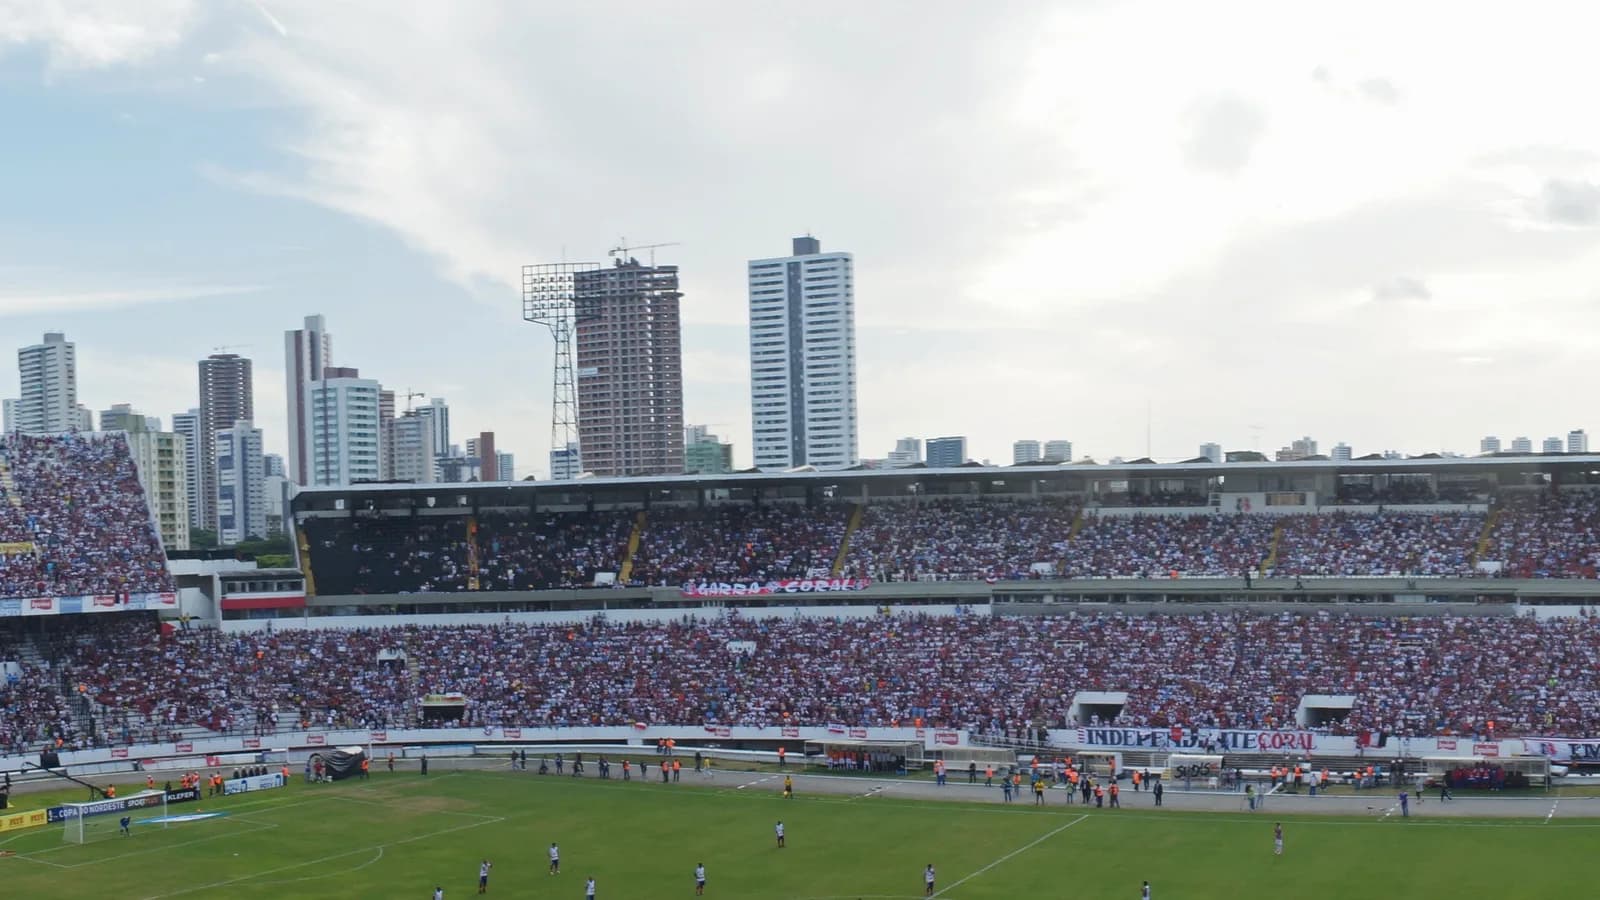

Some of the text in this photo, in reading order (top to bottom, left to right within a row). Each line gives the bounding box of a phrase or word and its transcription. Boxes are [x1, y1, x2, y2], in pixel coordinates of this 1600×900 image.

[785, 580, 852, 593] CORAL
[1086, 729, 1317, 750] INDEPENDTE CORAL
[167, 791, 195, 801] KLEFER
[59, 807, 79, 818] COPA
[89, 801, 125, 813] NORDESTE
